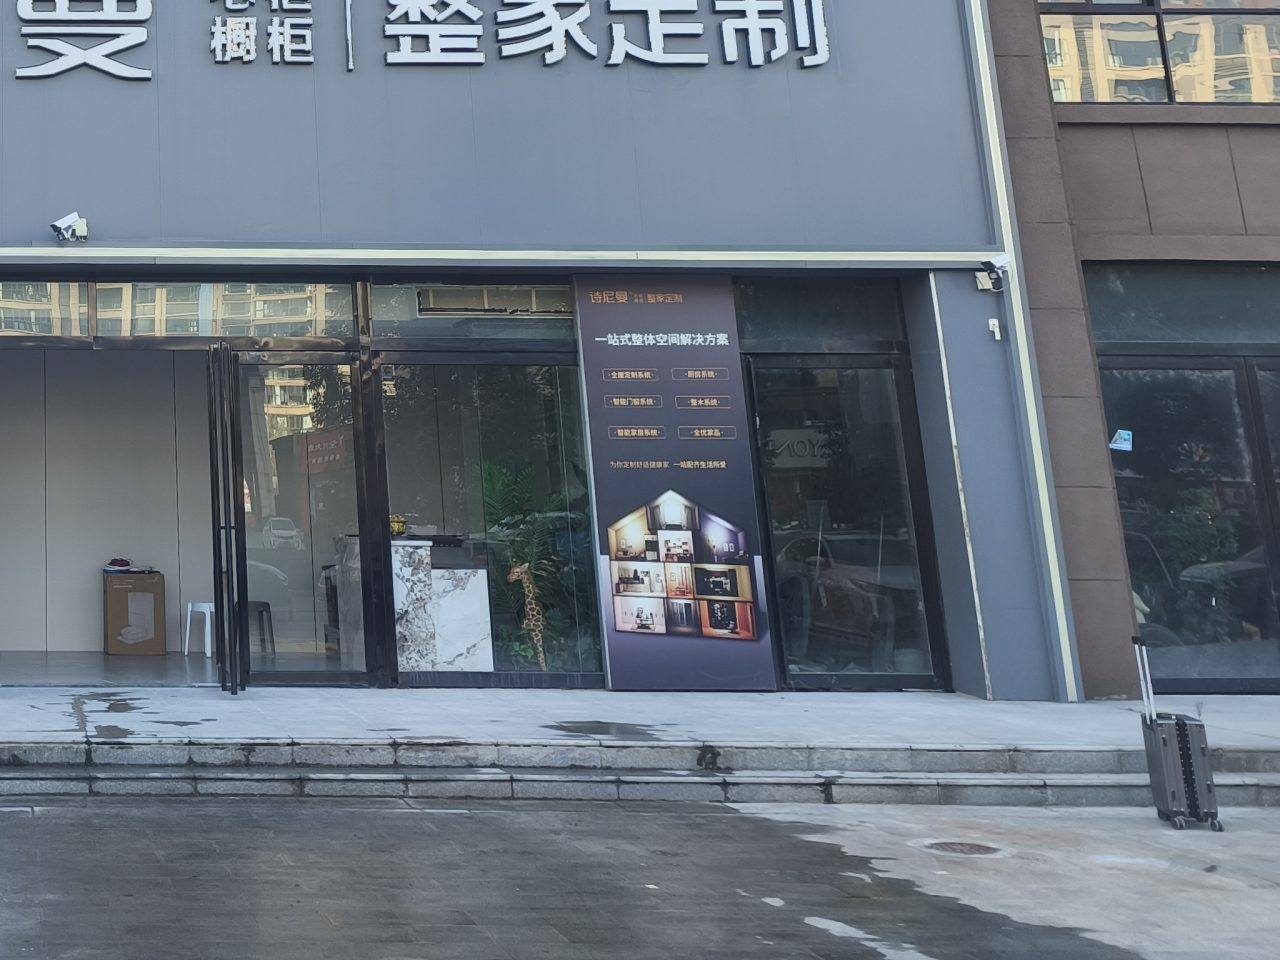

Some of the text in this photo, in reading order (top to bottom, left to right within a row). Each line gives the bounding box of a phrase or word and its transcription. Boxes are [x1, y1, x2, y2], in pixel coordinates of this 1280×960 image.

[595, 332, 730, 347] 一站式整体空间解决方案
